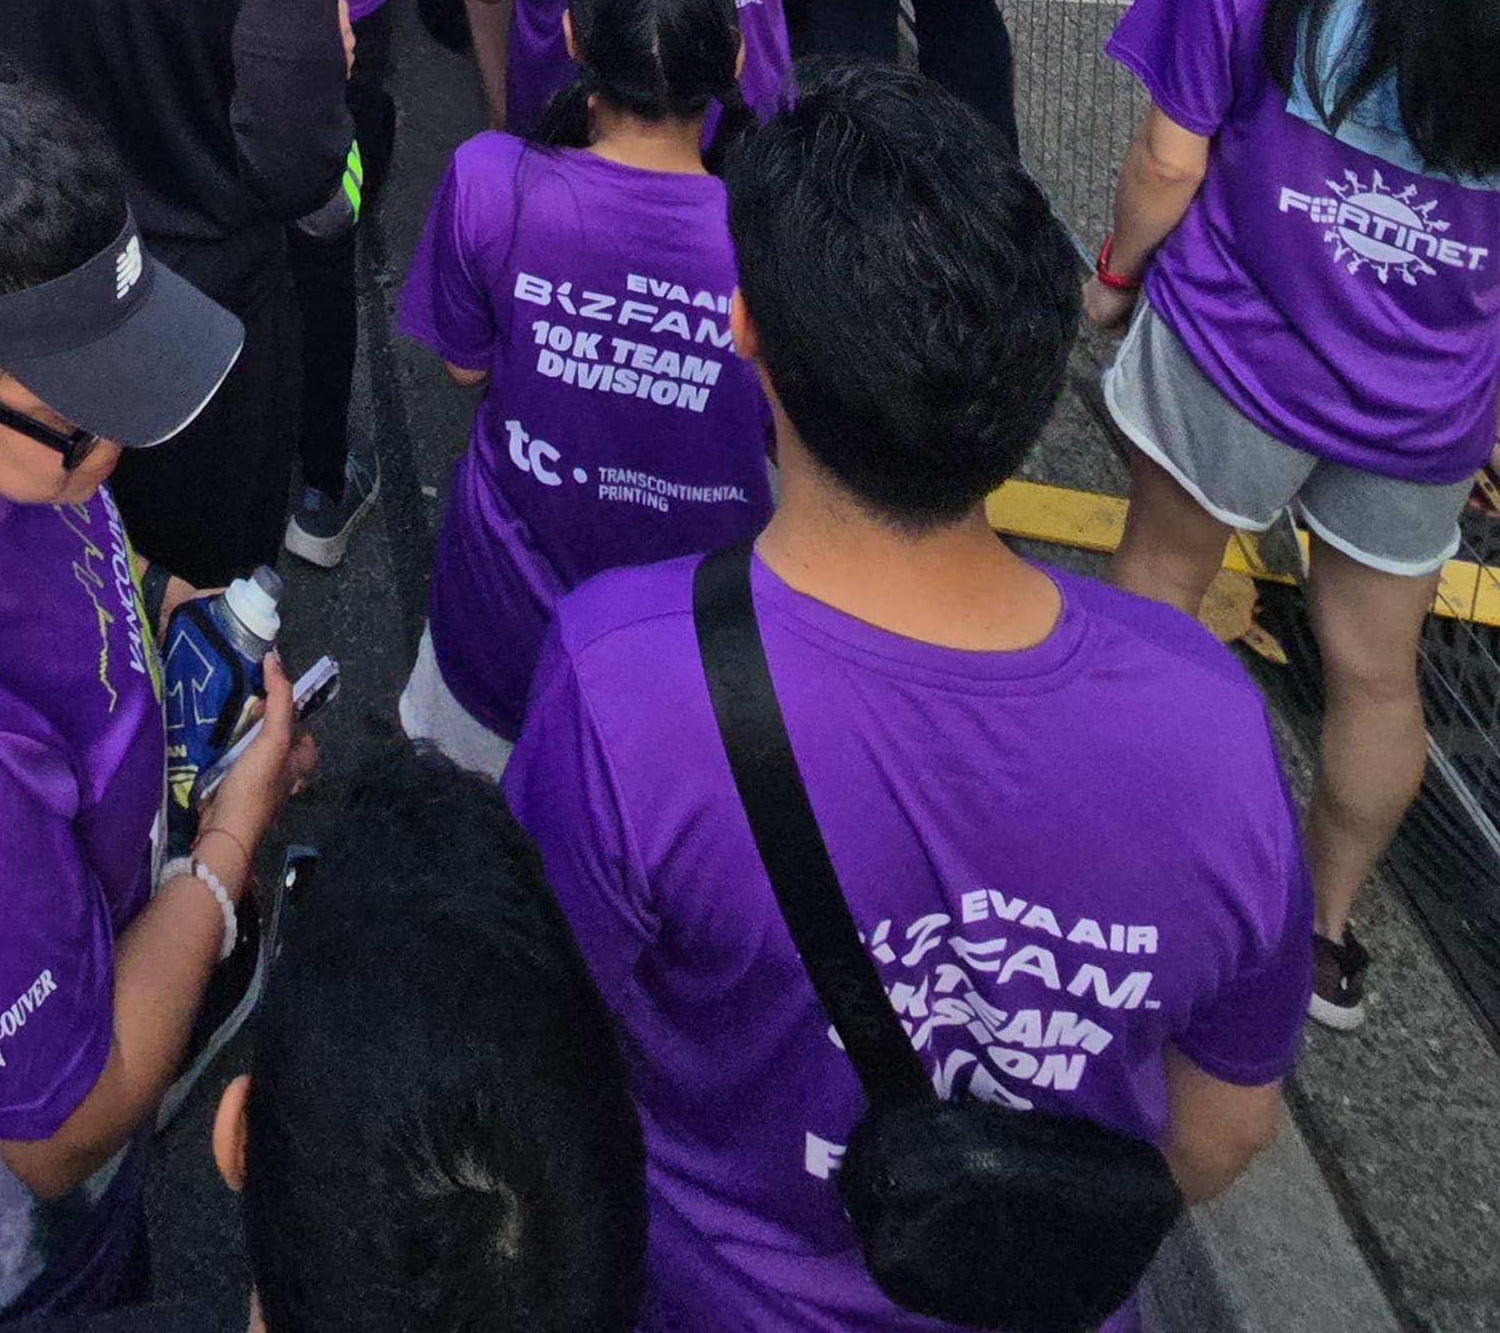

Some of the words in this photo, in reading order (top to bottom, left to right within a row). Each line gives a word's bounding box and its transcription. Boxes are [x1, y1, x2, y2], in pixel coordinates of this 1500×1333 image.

[1279, 186, 1489, 271] FORTINET
[532, 320, 603, 361] 10K
[611, 337, 723, 386] TEAM
[536, 348, 710, 414] DIVISION
[598, 466, 748, 504] TRANSCONTINENTAL
[598, 484, 669, 514] PRINTING
